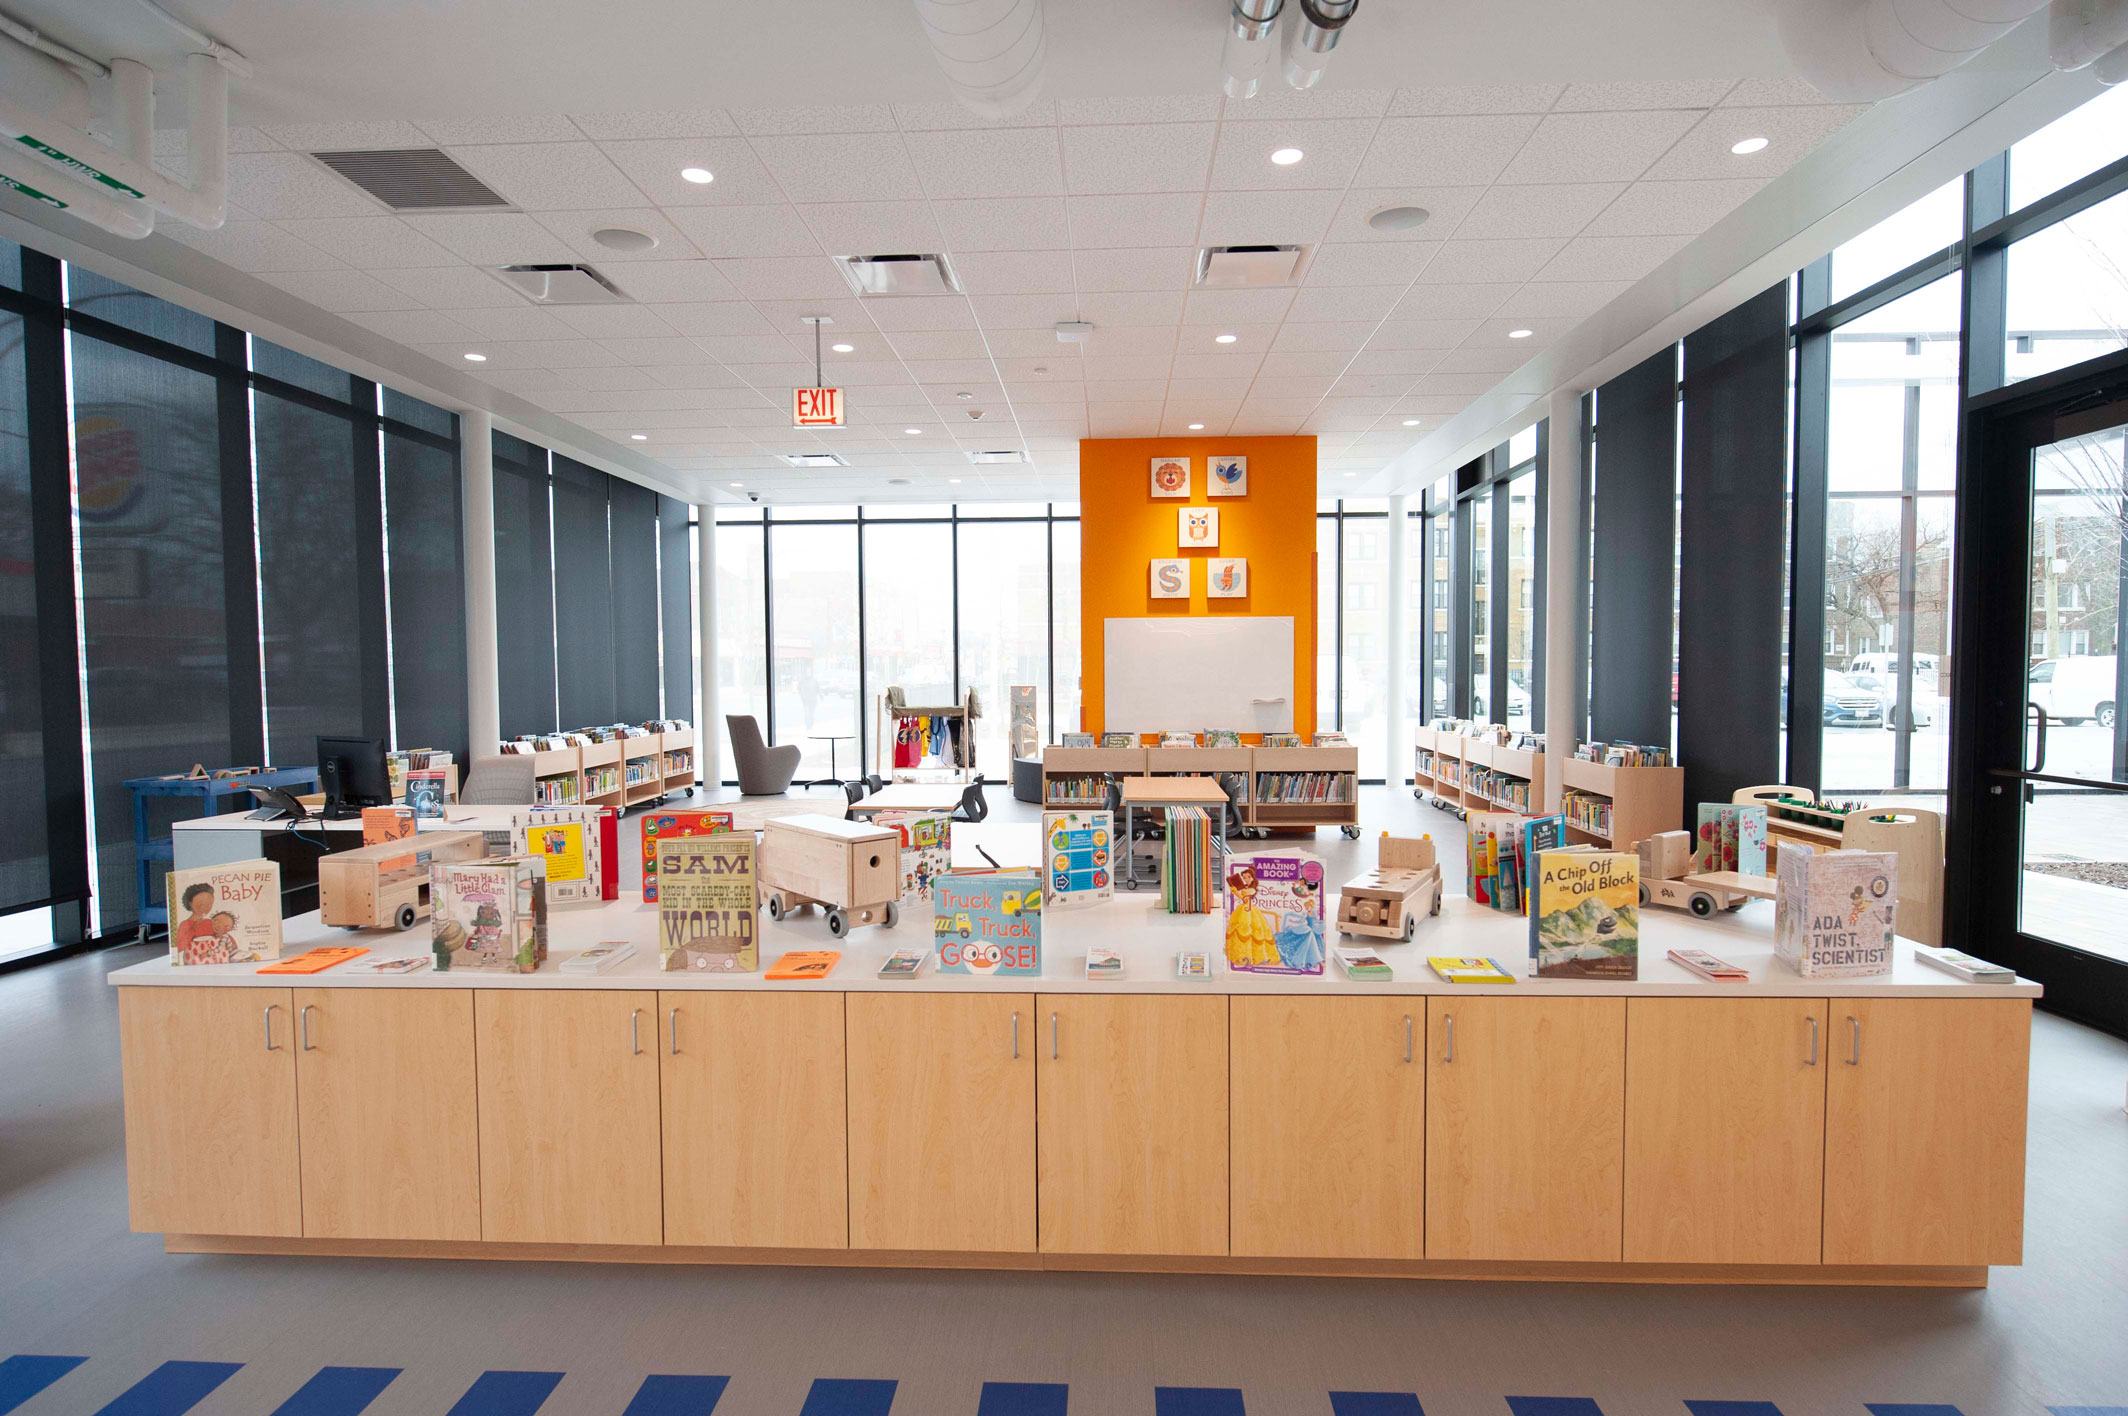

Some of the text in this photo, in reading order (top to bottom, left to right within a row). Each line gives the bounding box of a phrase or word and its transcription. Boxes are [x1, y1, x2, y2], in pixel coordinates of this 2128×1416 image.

[797, 388, 837, 416] EXIT
[410, 780, 440, 792] Cinderella
[662, 855, 749, 875] SAM
[1256, 863, 1297, 871] AMAZING
[1543, 858, 1613, 884] A Chip Off
[211, 872, 272, 884] PECAN PIE
[453, 872, 479, 883] Mary
[481, 873, 500, 884] Had
[1263, 870, 1290, 878] BOOK
[455, 883, 505, 895] Little Glam
[662, 885, 686, 896] MOST
[690, 885, 751, 896] SCAREDY-CAT
[1571, 879, 1595, 895] Old
[1599, 871, 1634, 890] Block
[221, 883, 263, 902] Baby
[940, 888, 997, 911] Truck,
[1261, 886, 1289, 899] Disney
[662, 897, 751, 908] KID IN THE WHOLE
[1244, 896, 1303, 912] PRINCESS
[662, 910, 752, 947] WORLD
[978, 917, 1037, 940] Truck,
[1813, 915, 1843, 930] ADA
[941, 942, 1037, 968] GOOSE!
[1812, 948, 1886, 966] SCIENTIST
